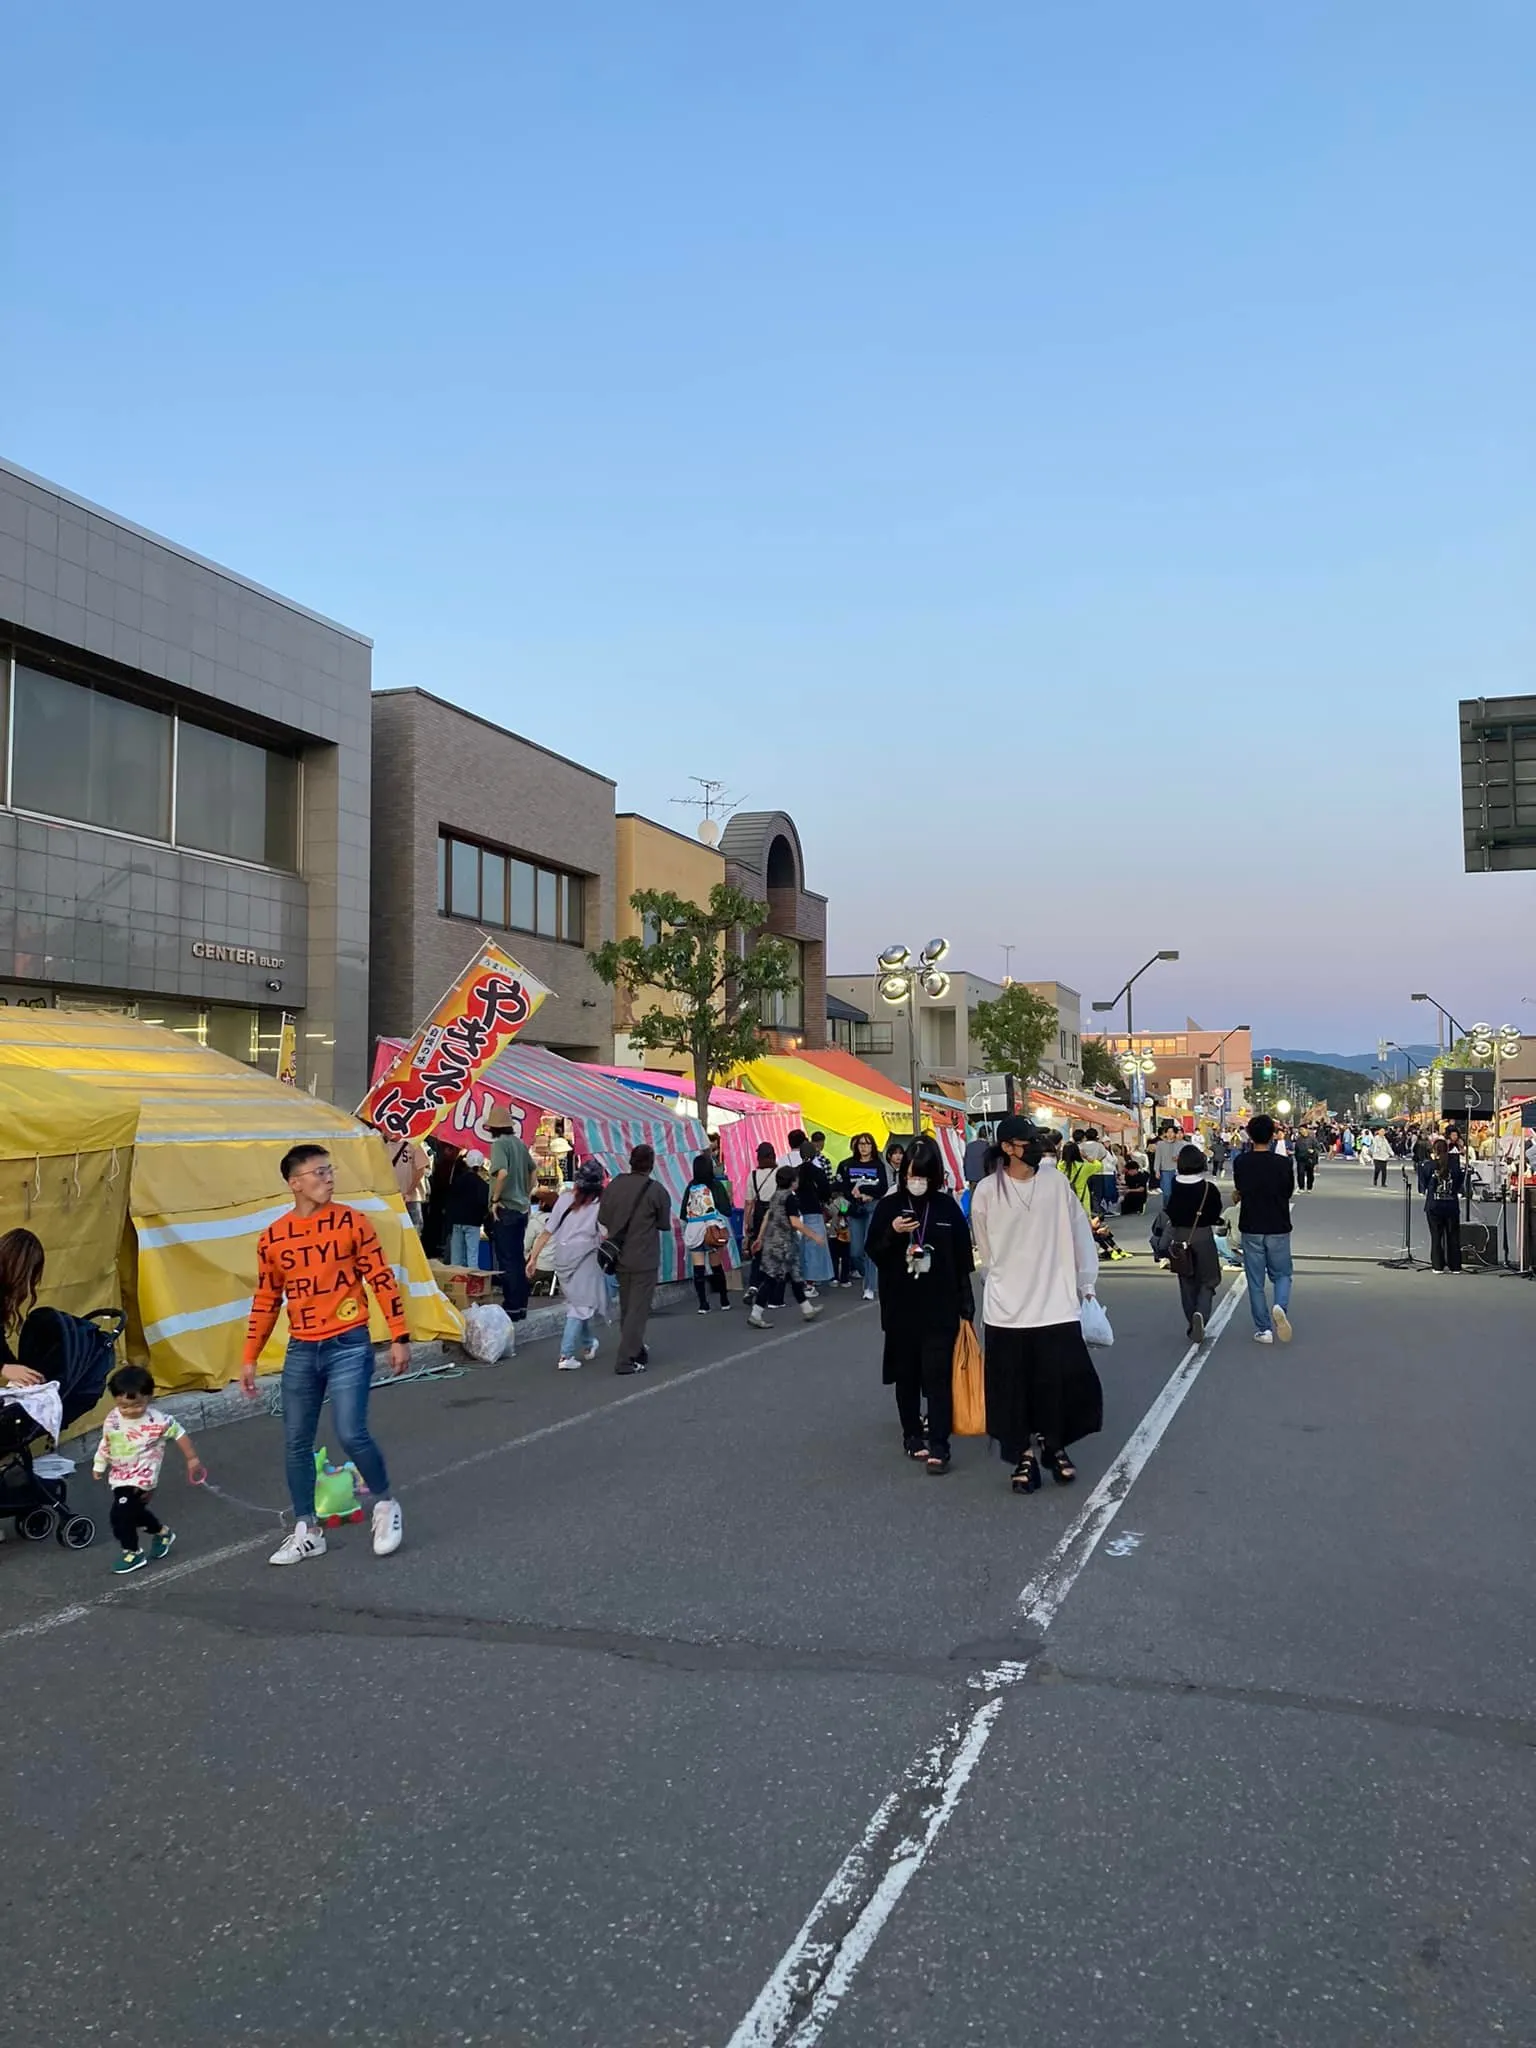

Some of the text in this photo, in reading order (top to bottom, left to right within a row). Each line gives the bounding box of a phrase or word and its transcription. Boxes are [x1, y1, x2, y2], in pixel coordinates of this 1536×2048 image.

[192, 942, 257, 965] CENTER
[373, 978, 530, 1137] やきそば
[260, 1211, 354, 1244] LL. HA
